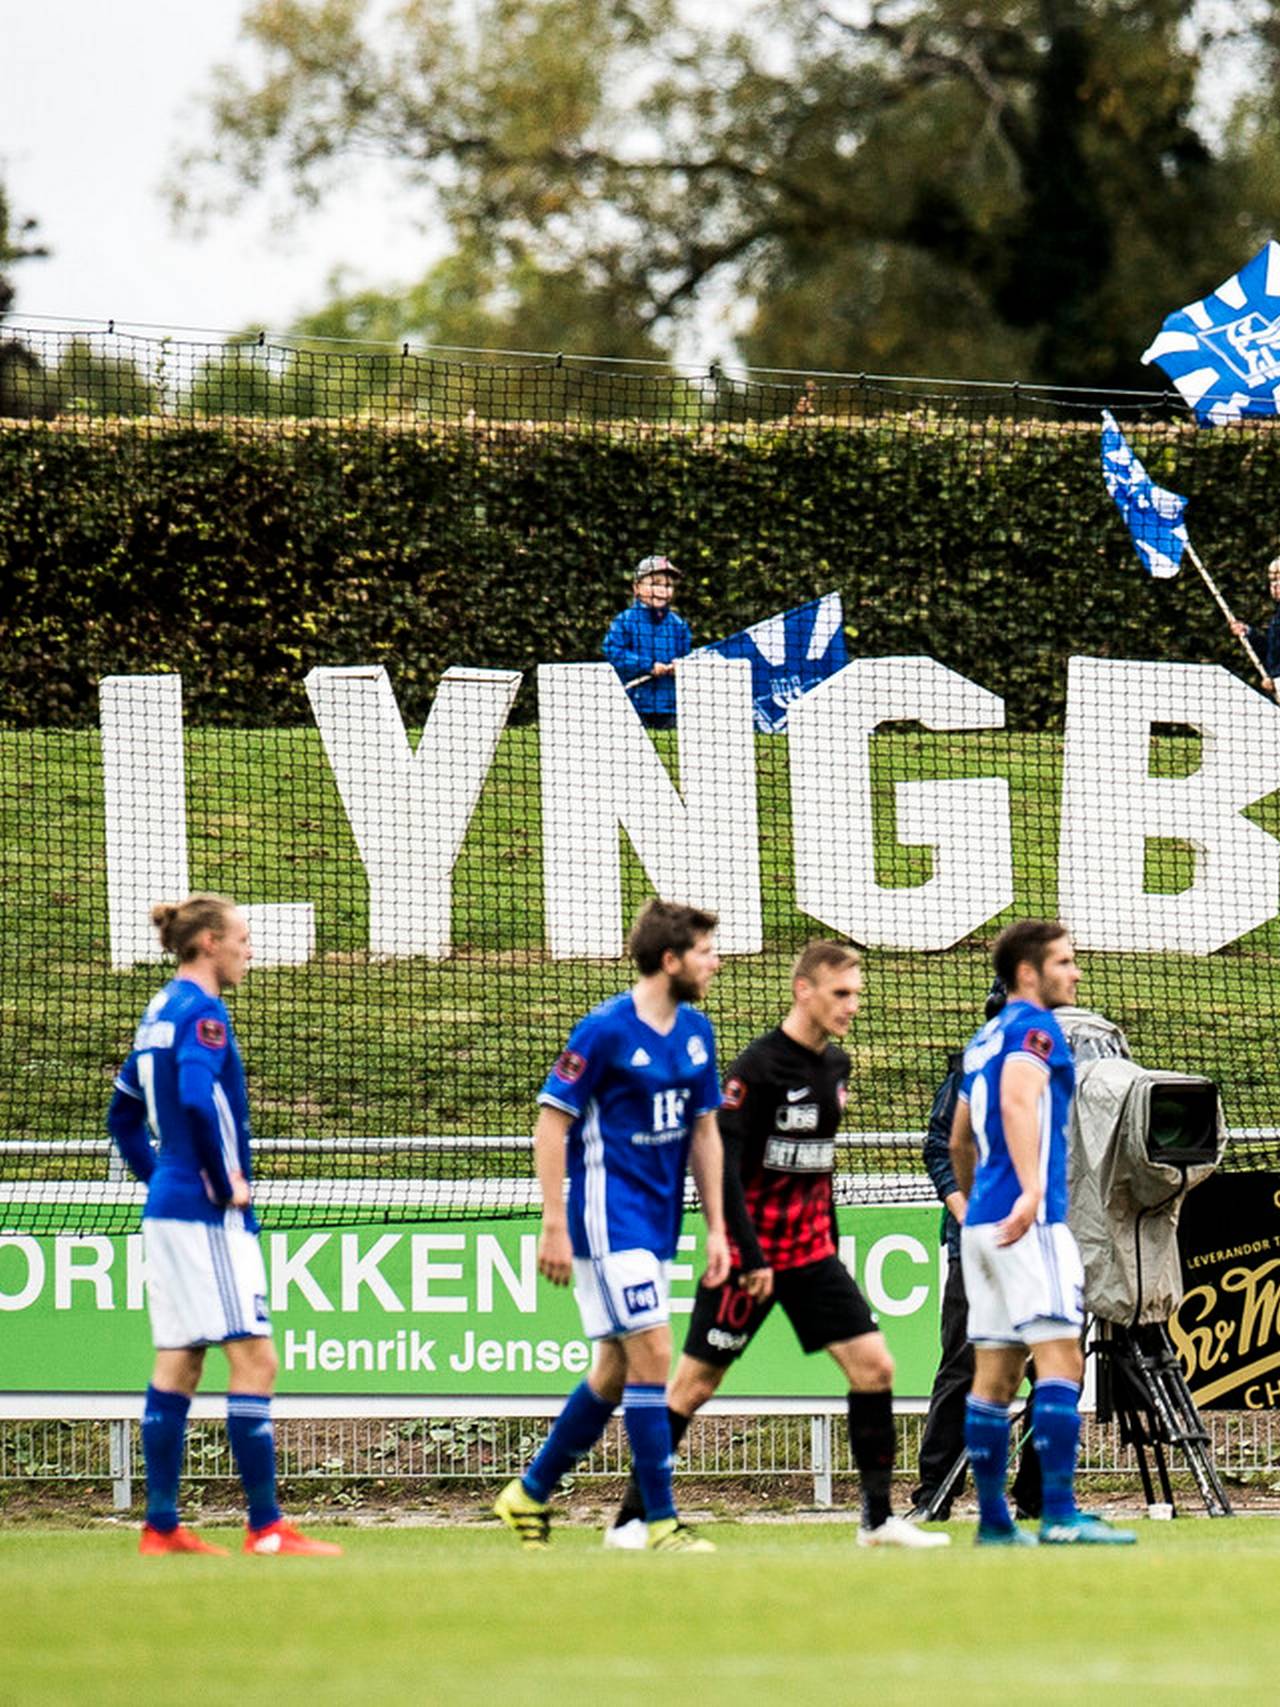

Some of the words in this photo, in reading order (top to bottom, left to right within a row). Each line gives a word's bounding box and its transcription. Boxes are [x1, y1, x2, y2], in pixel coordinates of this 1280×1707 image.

[1186, 1238, 1272, 1269] LEVERANDØR
[716, 1284, 751, 1328] 10
[284, 1330, 436, 1372] Henrik
